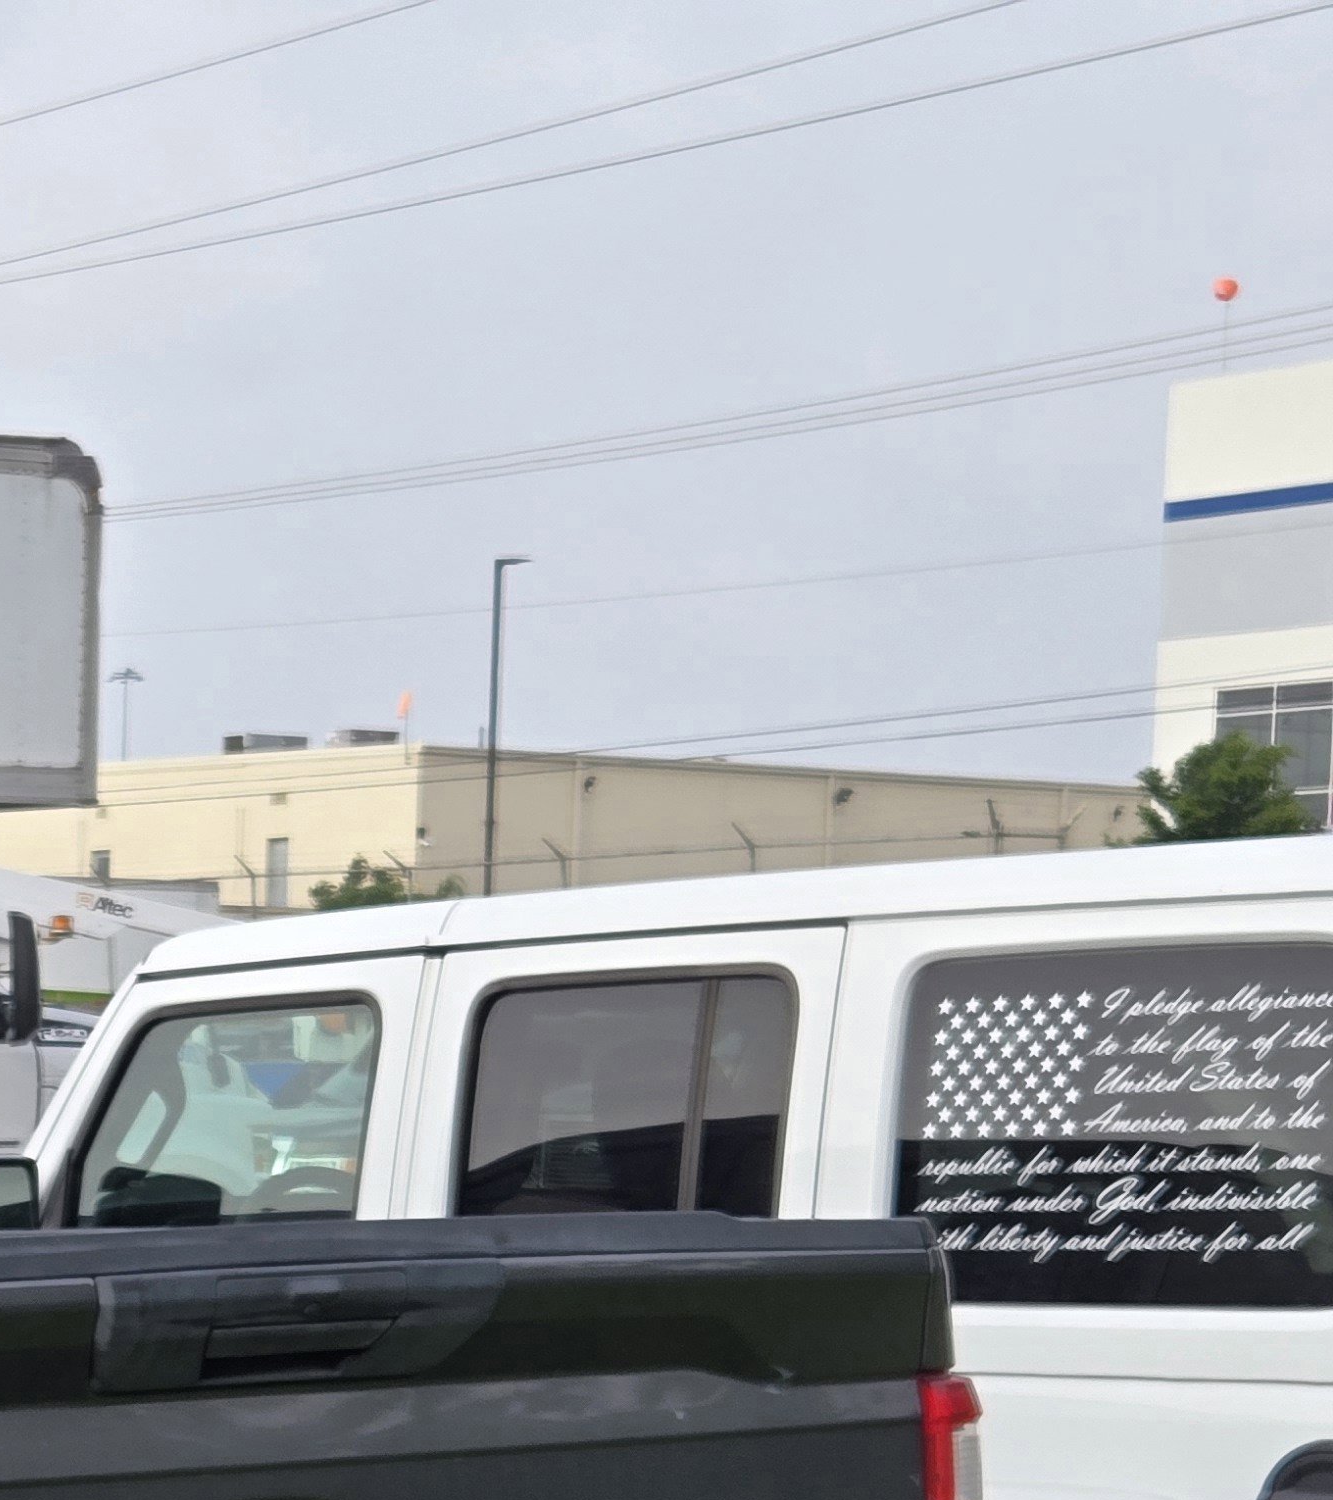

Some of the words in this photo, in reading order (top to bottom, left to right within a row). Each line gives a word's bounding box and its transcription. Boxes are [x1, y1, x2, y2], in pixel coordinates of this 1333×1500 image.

[89, 897, 134, 919] Altec
[1101, 988, 1130, 1018] I
[1118, 987, 1205, 1025] pledge
[1087, 1031, 1120, 1055] to
[1122, 1026, 1171, 1054] the
[1171, 1024, 1238, 1064] flag
[1244, 1020, 1291, 1061] of
[1281, 1018, 1333, 1048] the
[1094, 1063, 1195, 1094] United
[1189, 1061, 1280, 1092] States
[1286, 1058, 1332, 1100] of
[1083, 1100, 1189, 1134] America,
[1193, 1102, 1255, 1131] and
[1246, 1105, 1276, 1130] to
[1279, 1100, 1325, 1130] the
[916, 1145, 1017, 1184] republic
[1016, 1144, 1061, 1187] for
[1063, 1143, 1147, 1173] which
[1144, 1146, 1180, 1172] it
[1172, 1141, 1261, 1173] stands,
[1268, 1153, 1322, 1171] one
[912, 1187, 1001, 1212] nation
[1003, 1183, 1084, 1212] under
[1161, 1180, 1319, 1211] indivisible
[936, 1222, 974, 1250] ith
[971, 1222, 1060, 1263] liberty
[1058, 1223, 1125, 1250] and
[1106, 1226, 1205, 1262] justice
[1202, 1221, 1250, 1263] for
[1254, 1222, 1316, 1250] all
